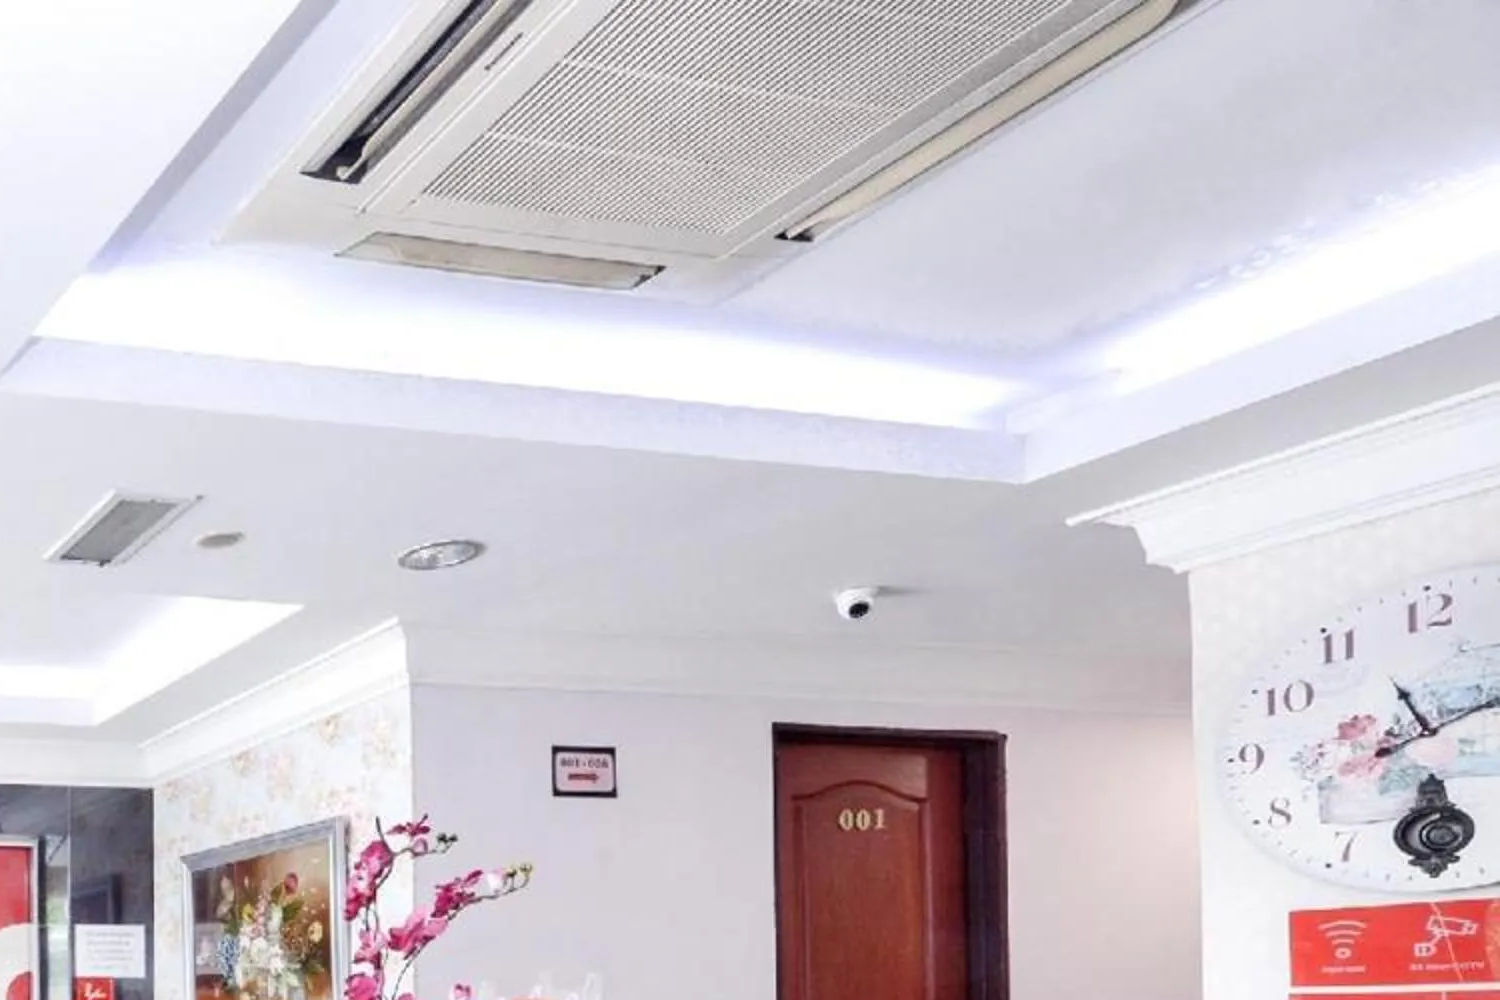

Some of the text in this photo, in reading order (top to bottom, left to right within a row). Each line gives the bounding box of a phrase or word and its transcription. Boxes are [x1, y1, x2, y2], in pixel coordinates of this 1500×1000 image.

[1407, 593, 1453, 634] 12
[1322, 629, 1356, 664] 11
[1264, 679, 1315, 717] 10
[1238, 742, 1265, 774] 9
[839, 808, 885, 831] 001
[1266, 797, 1293, 831] 8
[1334, 830, 1360, 863] 7
